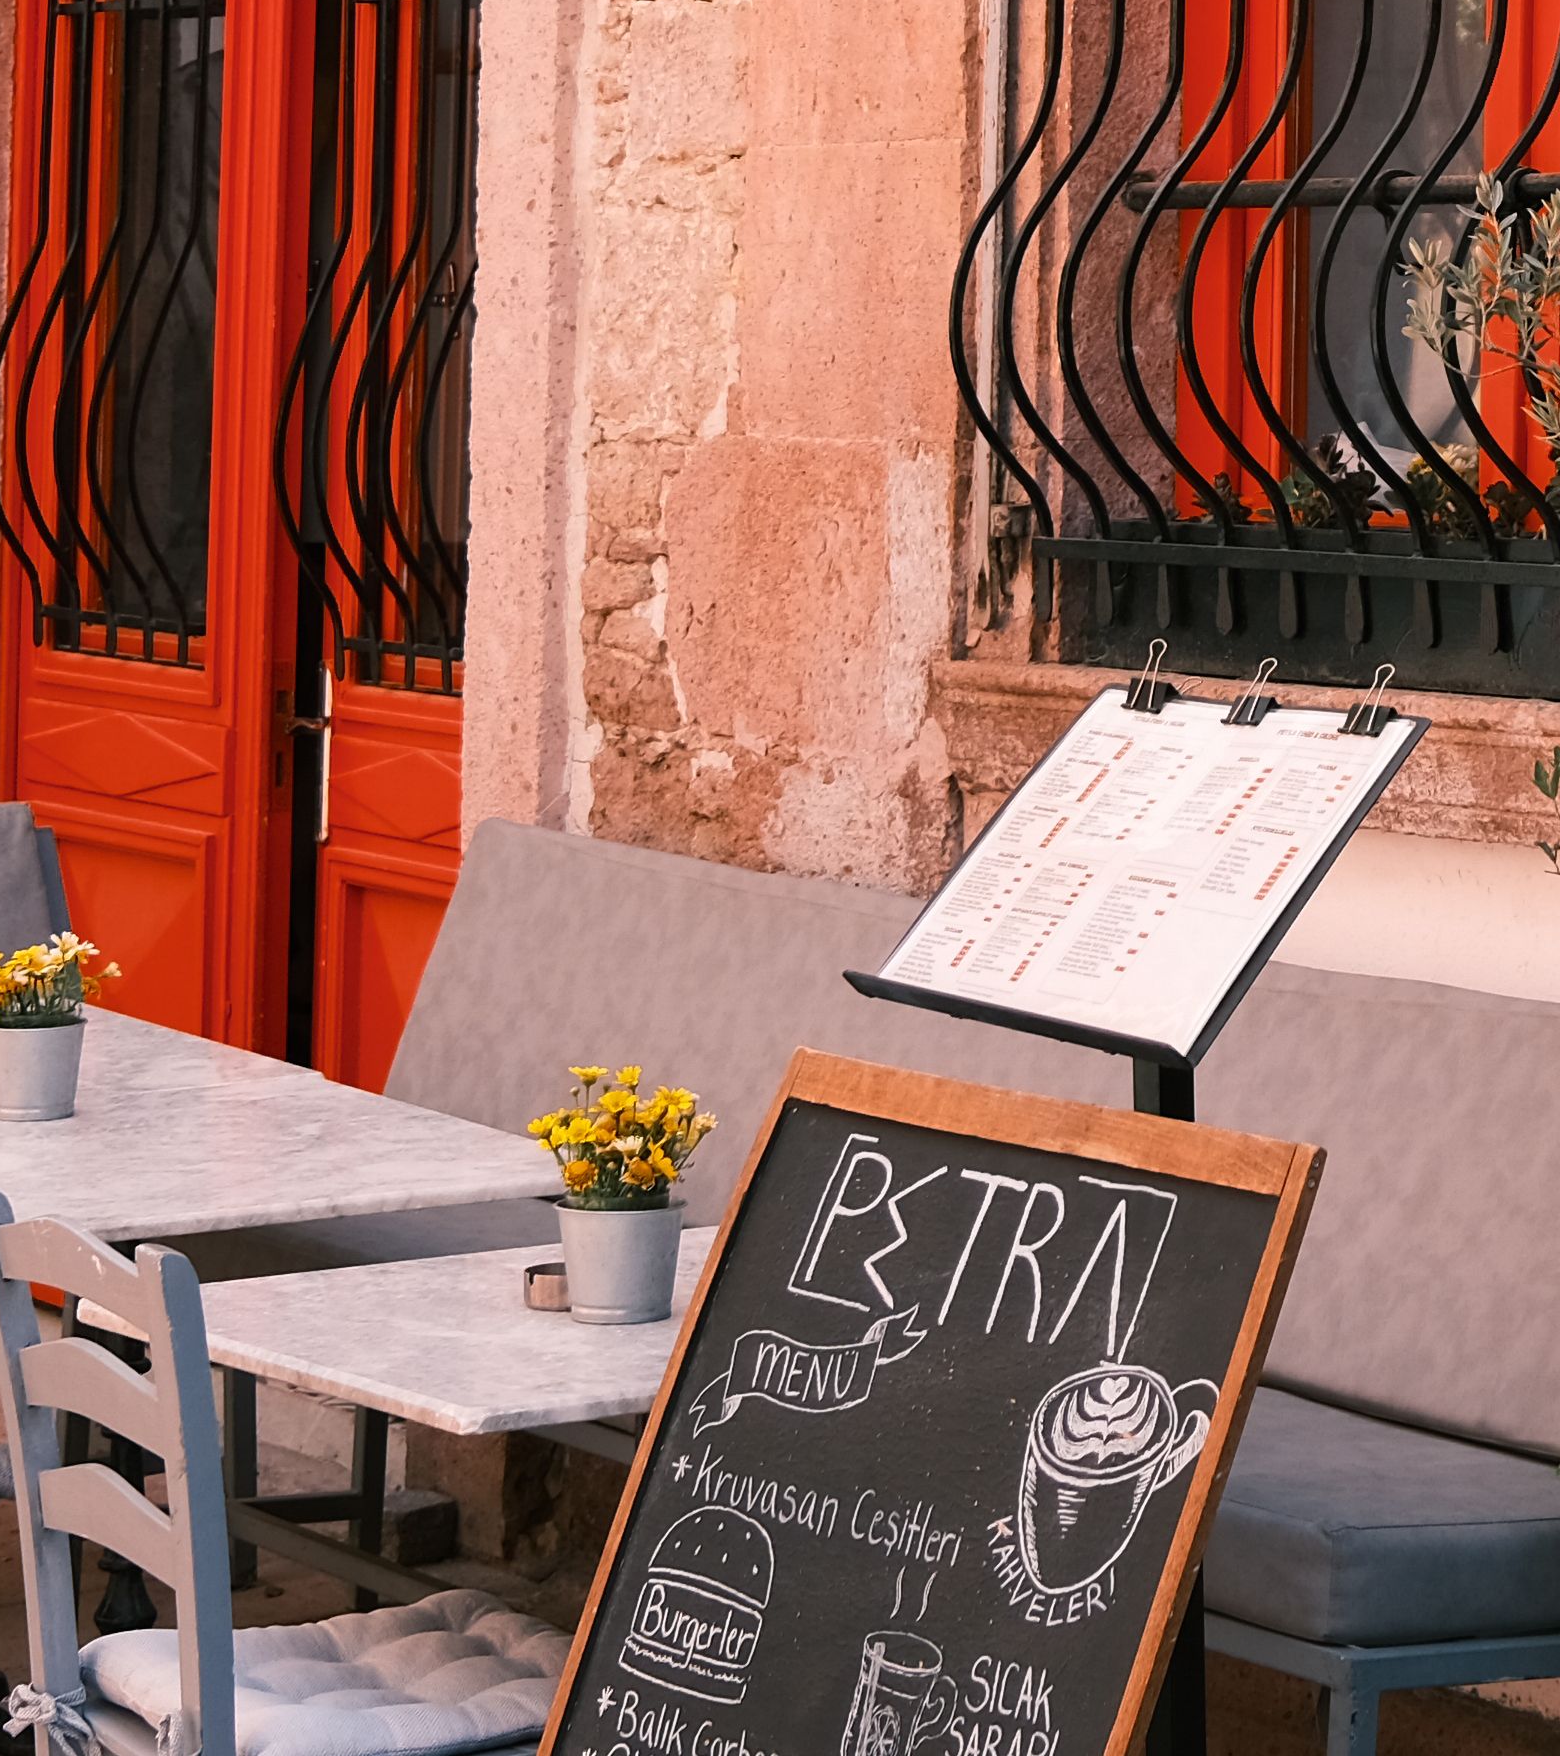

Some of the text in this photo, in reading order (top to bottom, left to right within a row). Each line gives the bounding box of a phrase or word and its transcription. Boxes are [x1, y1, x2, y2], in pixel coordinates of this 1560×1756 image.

[691, 1443, 839, 1538] Kruvasan
[987, 1515, 1116, 1626] KAHVELER!
[640, 1583, 755, 1668] Burgerler
[965, 1655, 1054, 1732] SICAK
